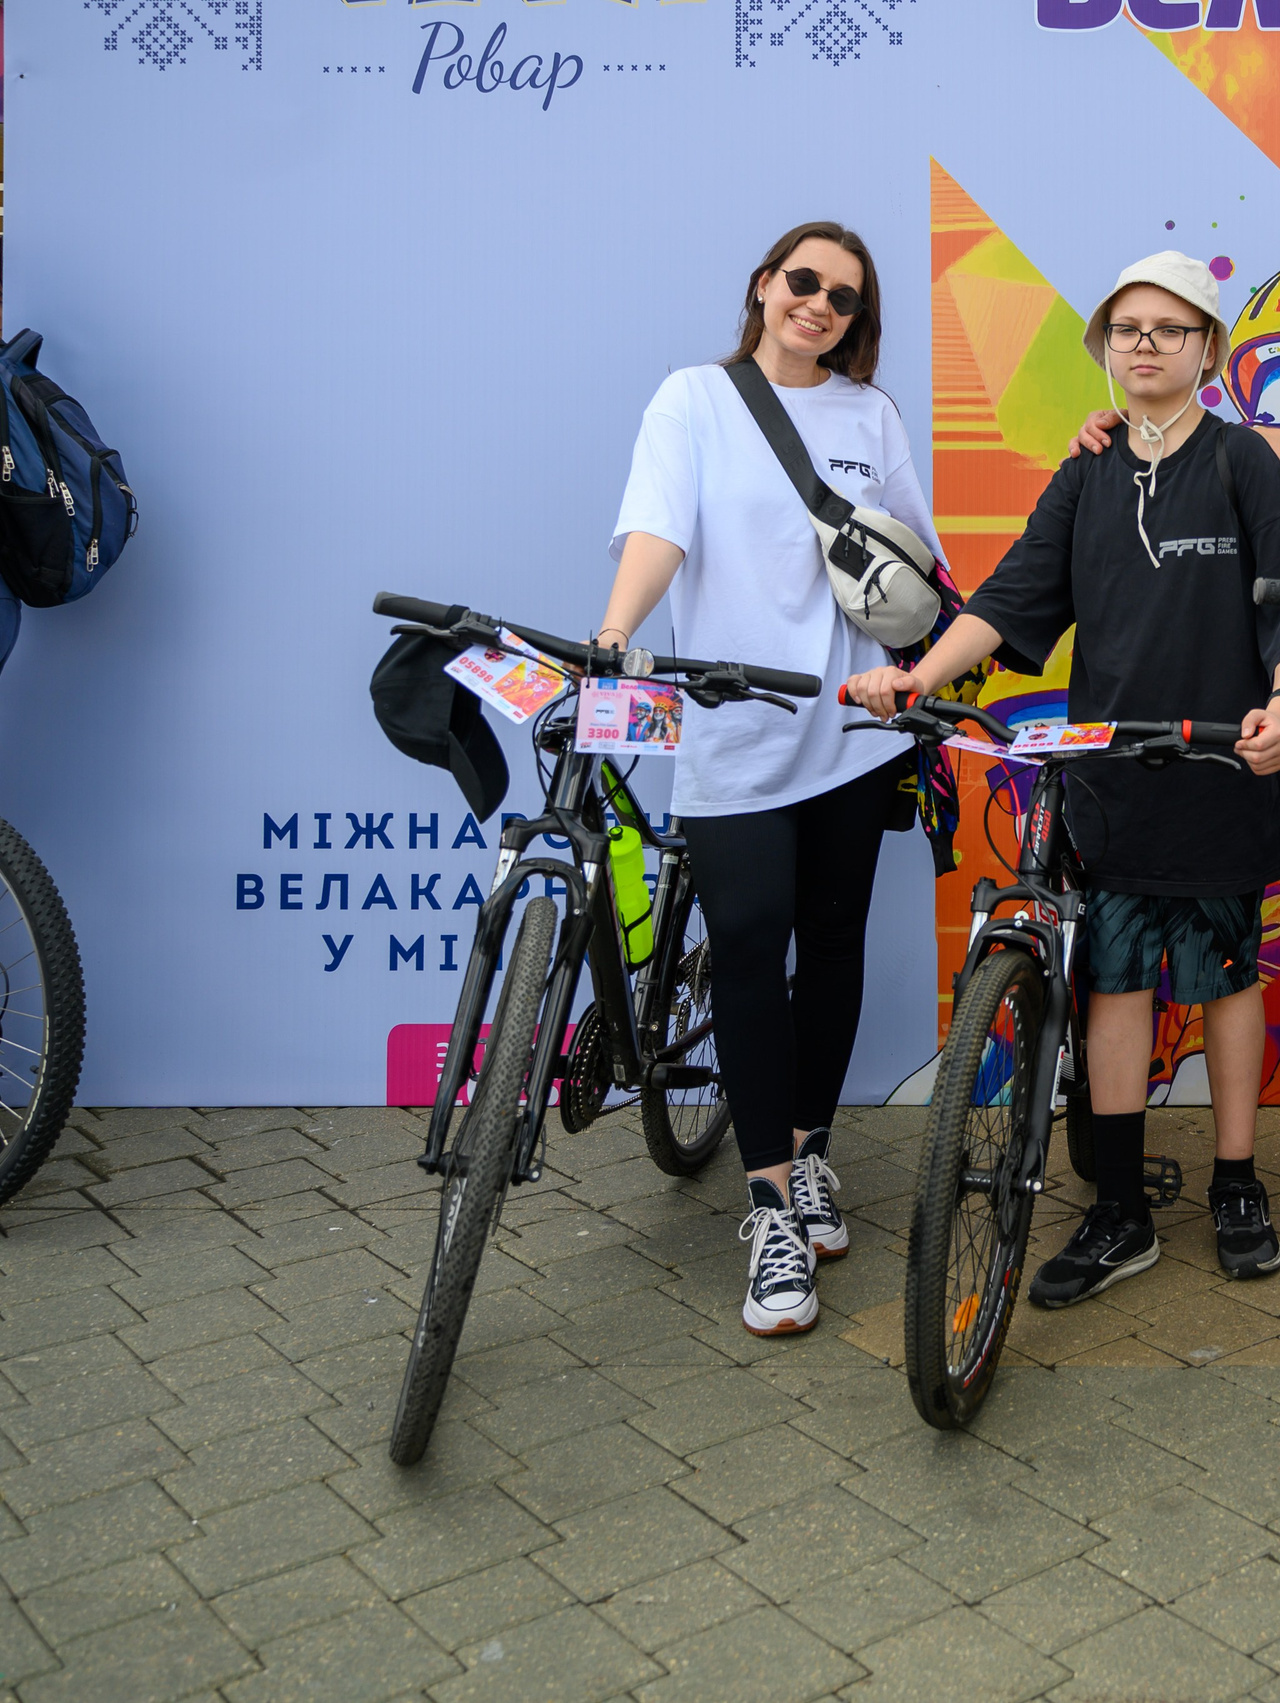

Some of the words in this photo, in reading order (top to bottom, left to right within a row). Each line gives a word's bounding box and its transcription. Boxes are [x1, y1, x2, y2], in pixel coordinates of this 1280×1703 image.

[412, 21, 584, 111] Ровар
[828, 458, 871, 479] PFG
[1158, 537, 1216, 559] PFG
[459, 656, 494, 684] 05898
[588, 728, 619, 739] 3300
[1034, 807, 1045, 855] BANDIT
[322, 934, 354, 972] У
